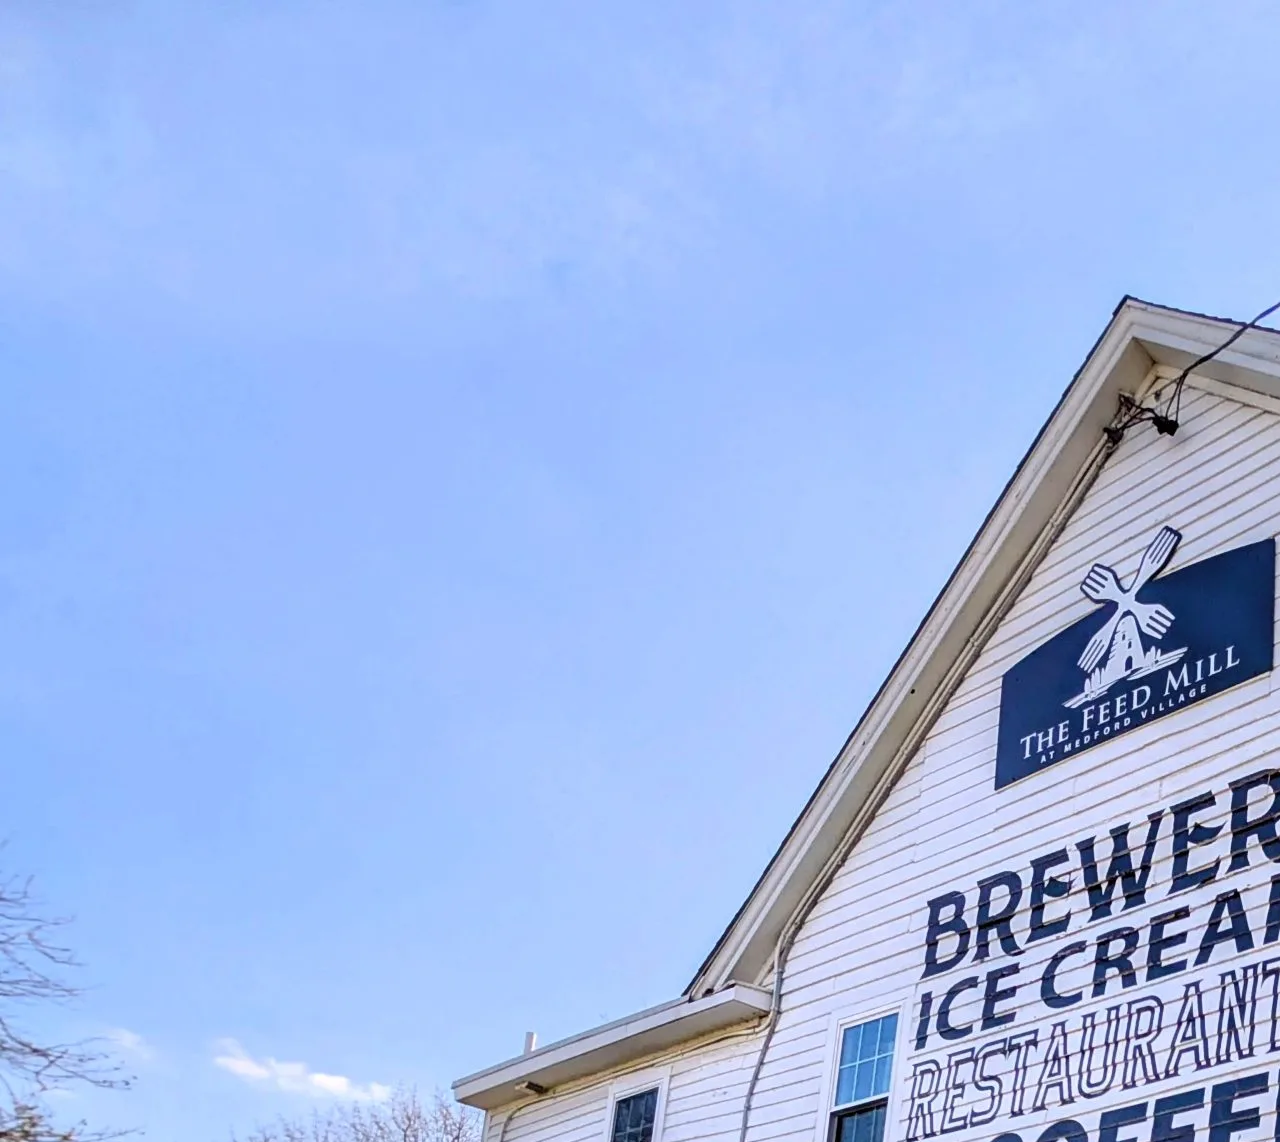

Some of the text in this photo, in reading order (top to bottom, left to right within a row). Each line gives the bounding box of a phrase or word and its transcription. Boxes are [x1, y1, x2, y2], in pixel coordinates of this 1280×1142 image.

[1020, 645, 1240, 760] THE FEED MILL
[1040, 683, 1207, 764] AT MEDFORD VILLAGE
[914, 962, 1020, 1051] ICE
